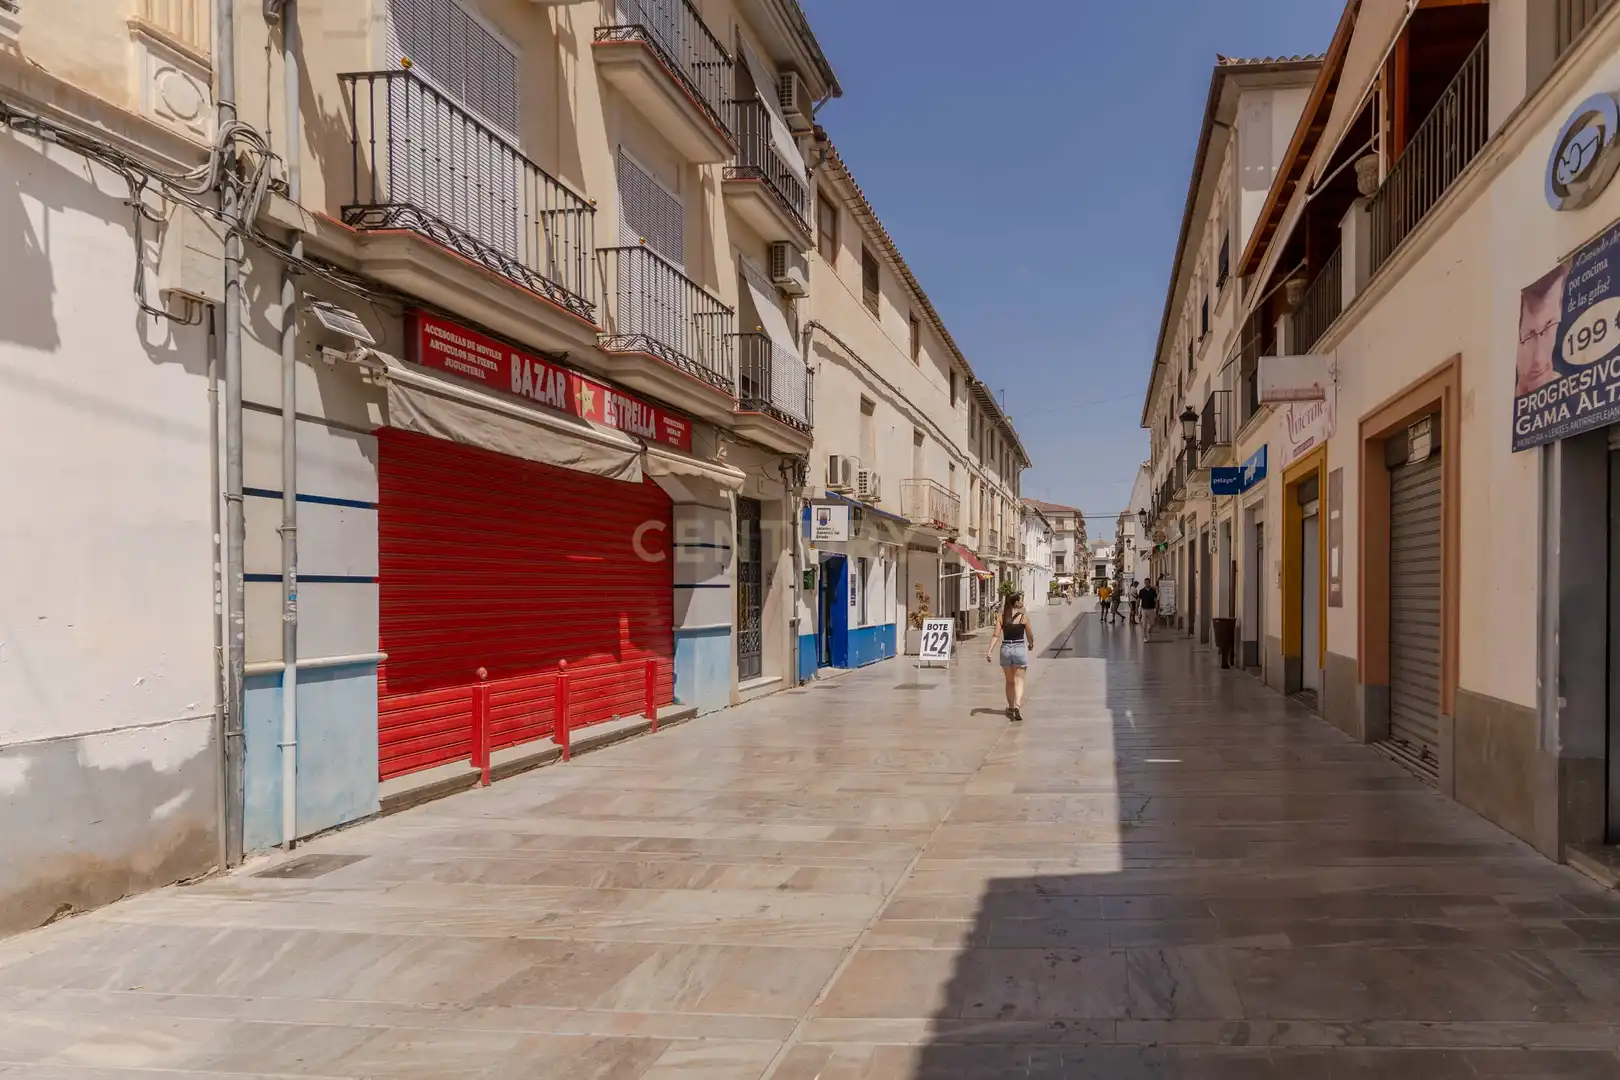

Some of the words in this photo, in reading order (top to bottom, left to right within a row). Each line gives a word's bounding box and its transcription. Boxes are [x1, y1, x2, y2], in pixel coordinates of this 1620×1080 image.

[1568, 275, 1581, 296] por
[1581, 258, 1608, 283] encima
[1567, 297, 1577, 313] de
[1577, 291, 1588, 307] las
[1588, 276, 1611, 305] gafas?
[466, 339, 476, 350] DE
[476, 344, 503, 361] MOVILES
[1567, 318, 1608, 355] 199
[429, 338, 467, 360] ARTICULOS
[467, 352, 477, 364] DE
[477, 355, 499, 372] FIESTA
[510, 353, 566, 409] BAZAR
[603, 390, 657, 440] ESTRELLA
[1515, 402, 1571, 435] GAMA
[1576, 382, 1620, 415] ALT
[1548, 423, 1569, 437] LENTES
[1213, 477, 1234, 485] pelayo
[922, 631, 949, 654] 122
[926, 623, 949, 631] BOTE
